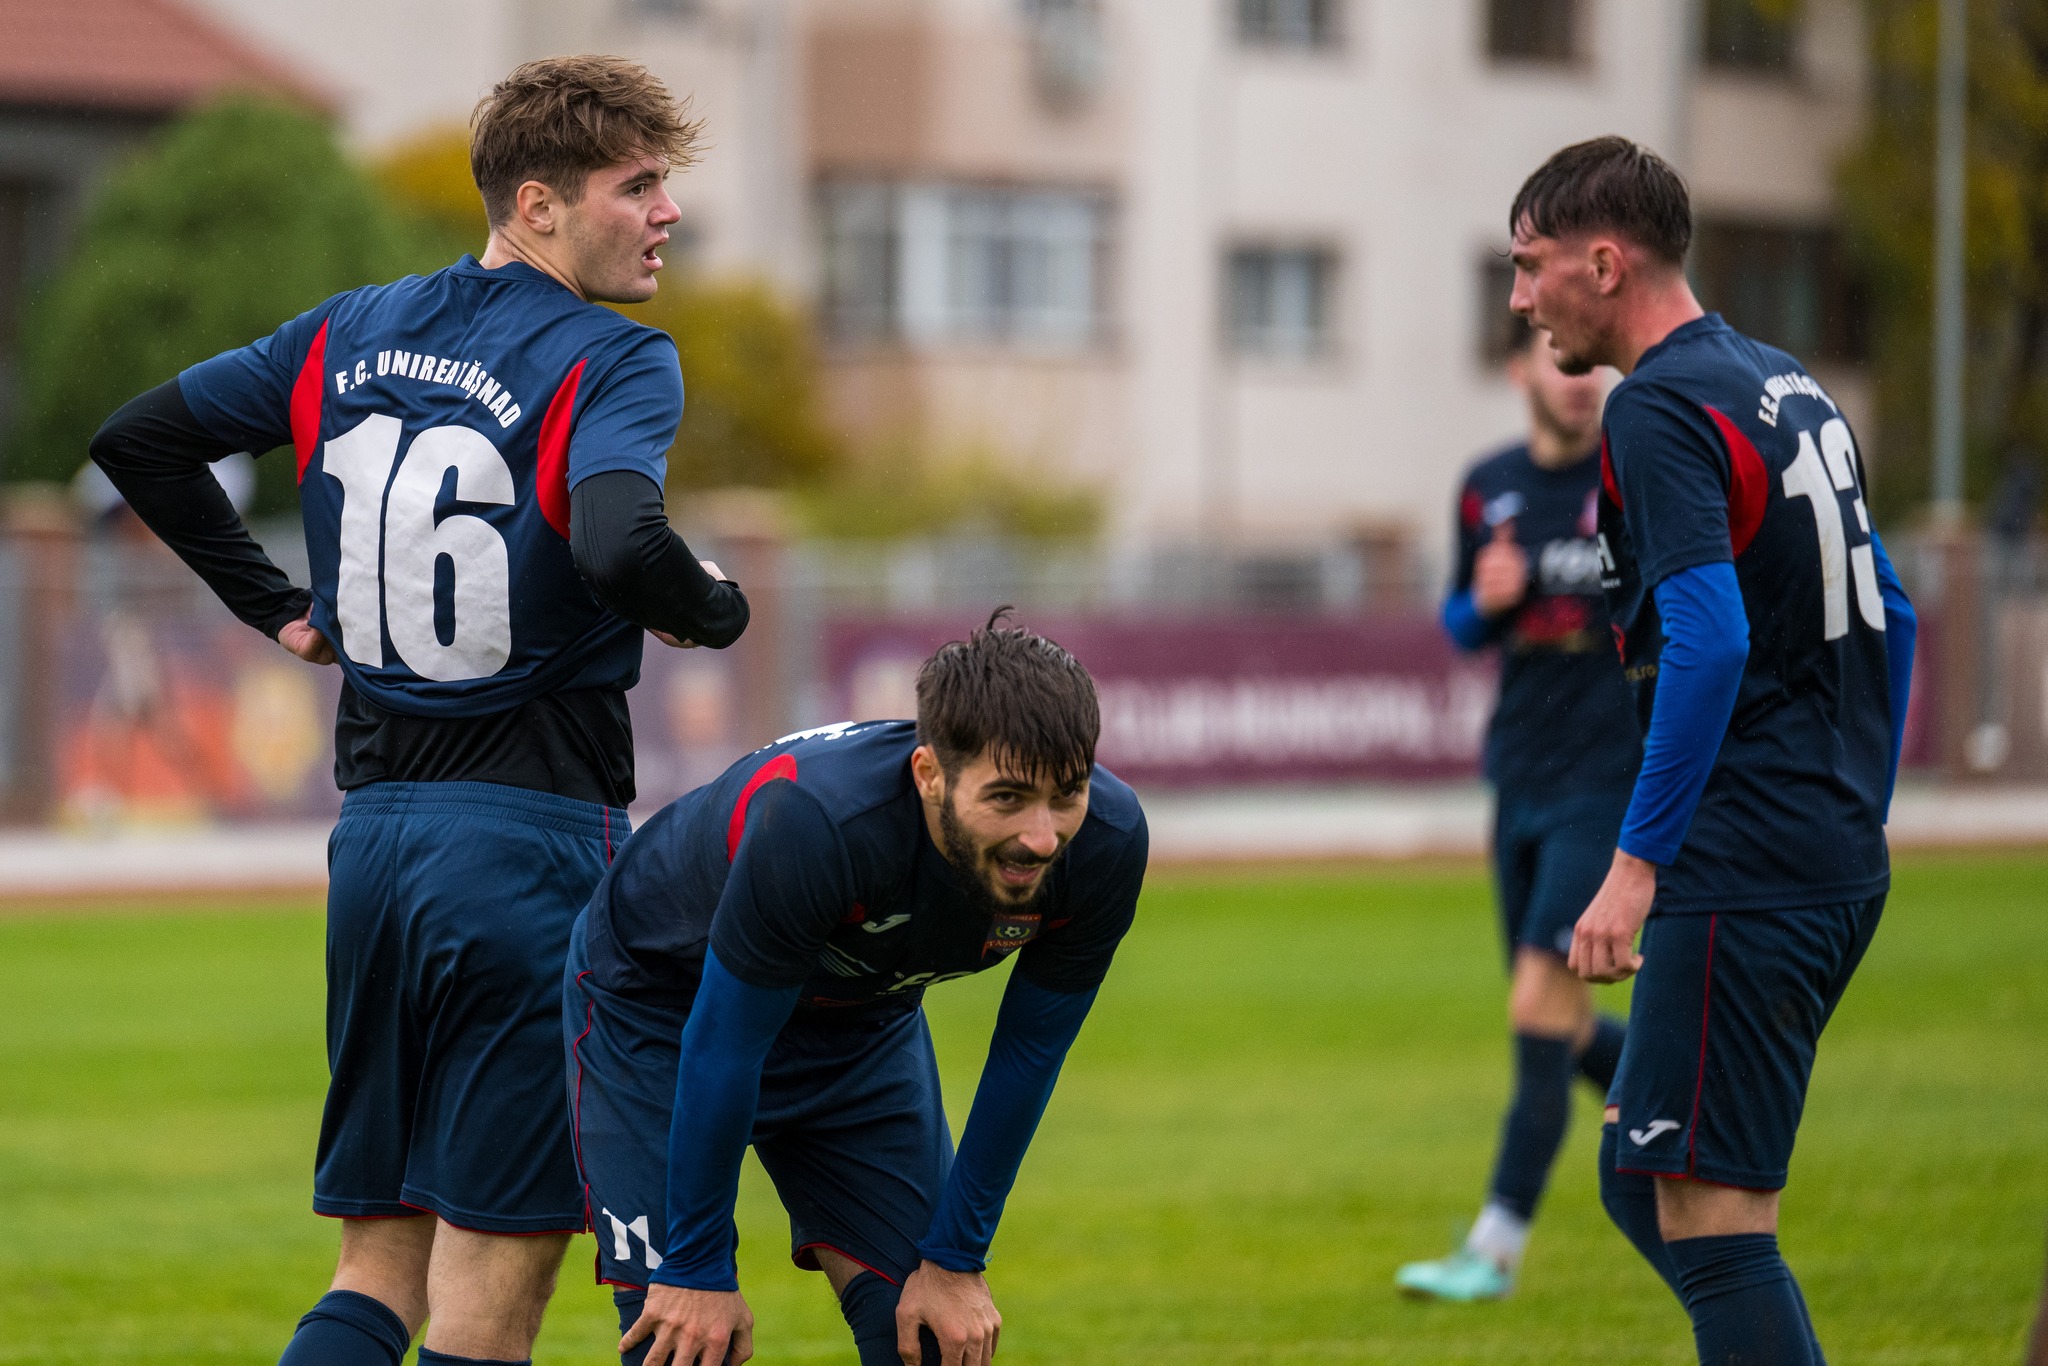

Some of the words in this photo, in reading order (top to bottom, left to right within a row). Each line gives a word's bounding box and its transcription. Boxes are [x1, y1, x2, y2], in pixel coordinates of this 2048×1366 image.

[335, 360, 372, 395] F.C.
[376, 349, 461, 385] UNIREA
[322, 412, 516, 682] 16
[1781, 417, 1887, 642] 13
